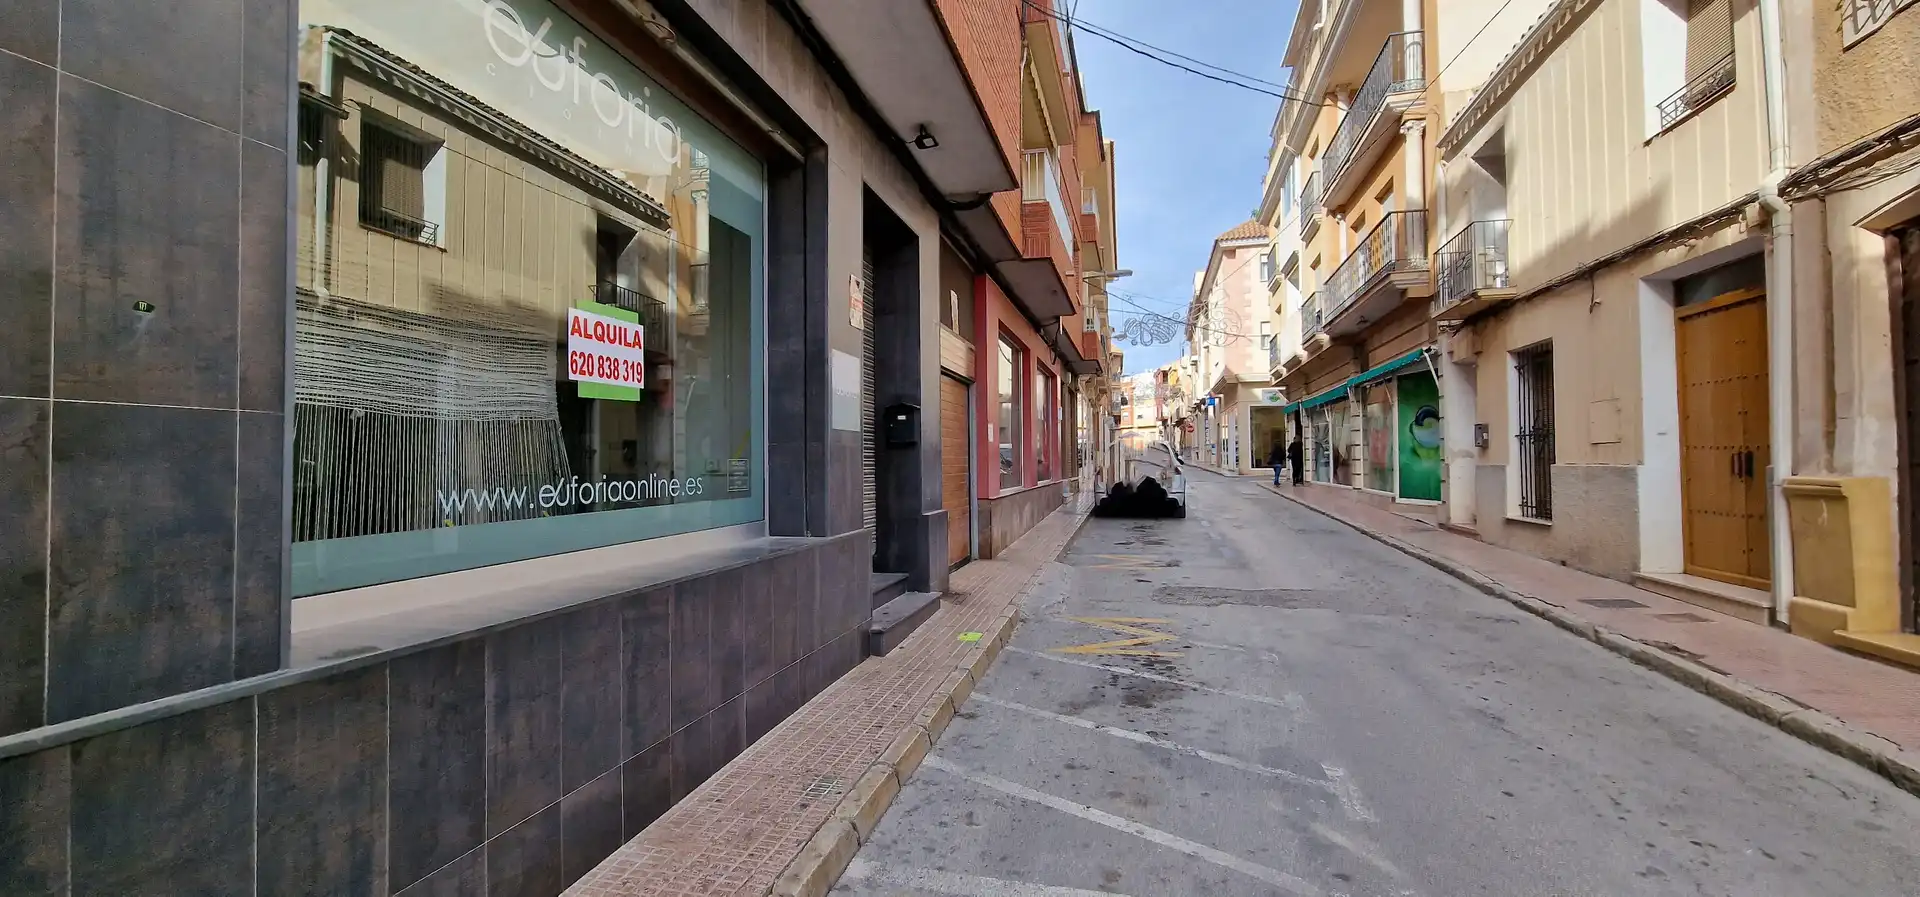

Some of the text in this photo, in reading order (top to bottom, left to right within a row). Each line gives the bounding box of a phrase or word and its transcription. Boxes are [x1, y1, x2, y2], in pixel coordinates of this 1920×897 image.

[484, 0, 682, 168] euforia
[570, 315, 642, 350] ALQUILA
[570, 350, 643, 384] 620 838 319
[437, 472, 703, 516] www.euforiaonline.es
